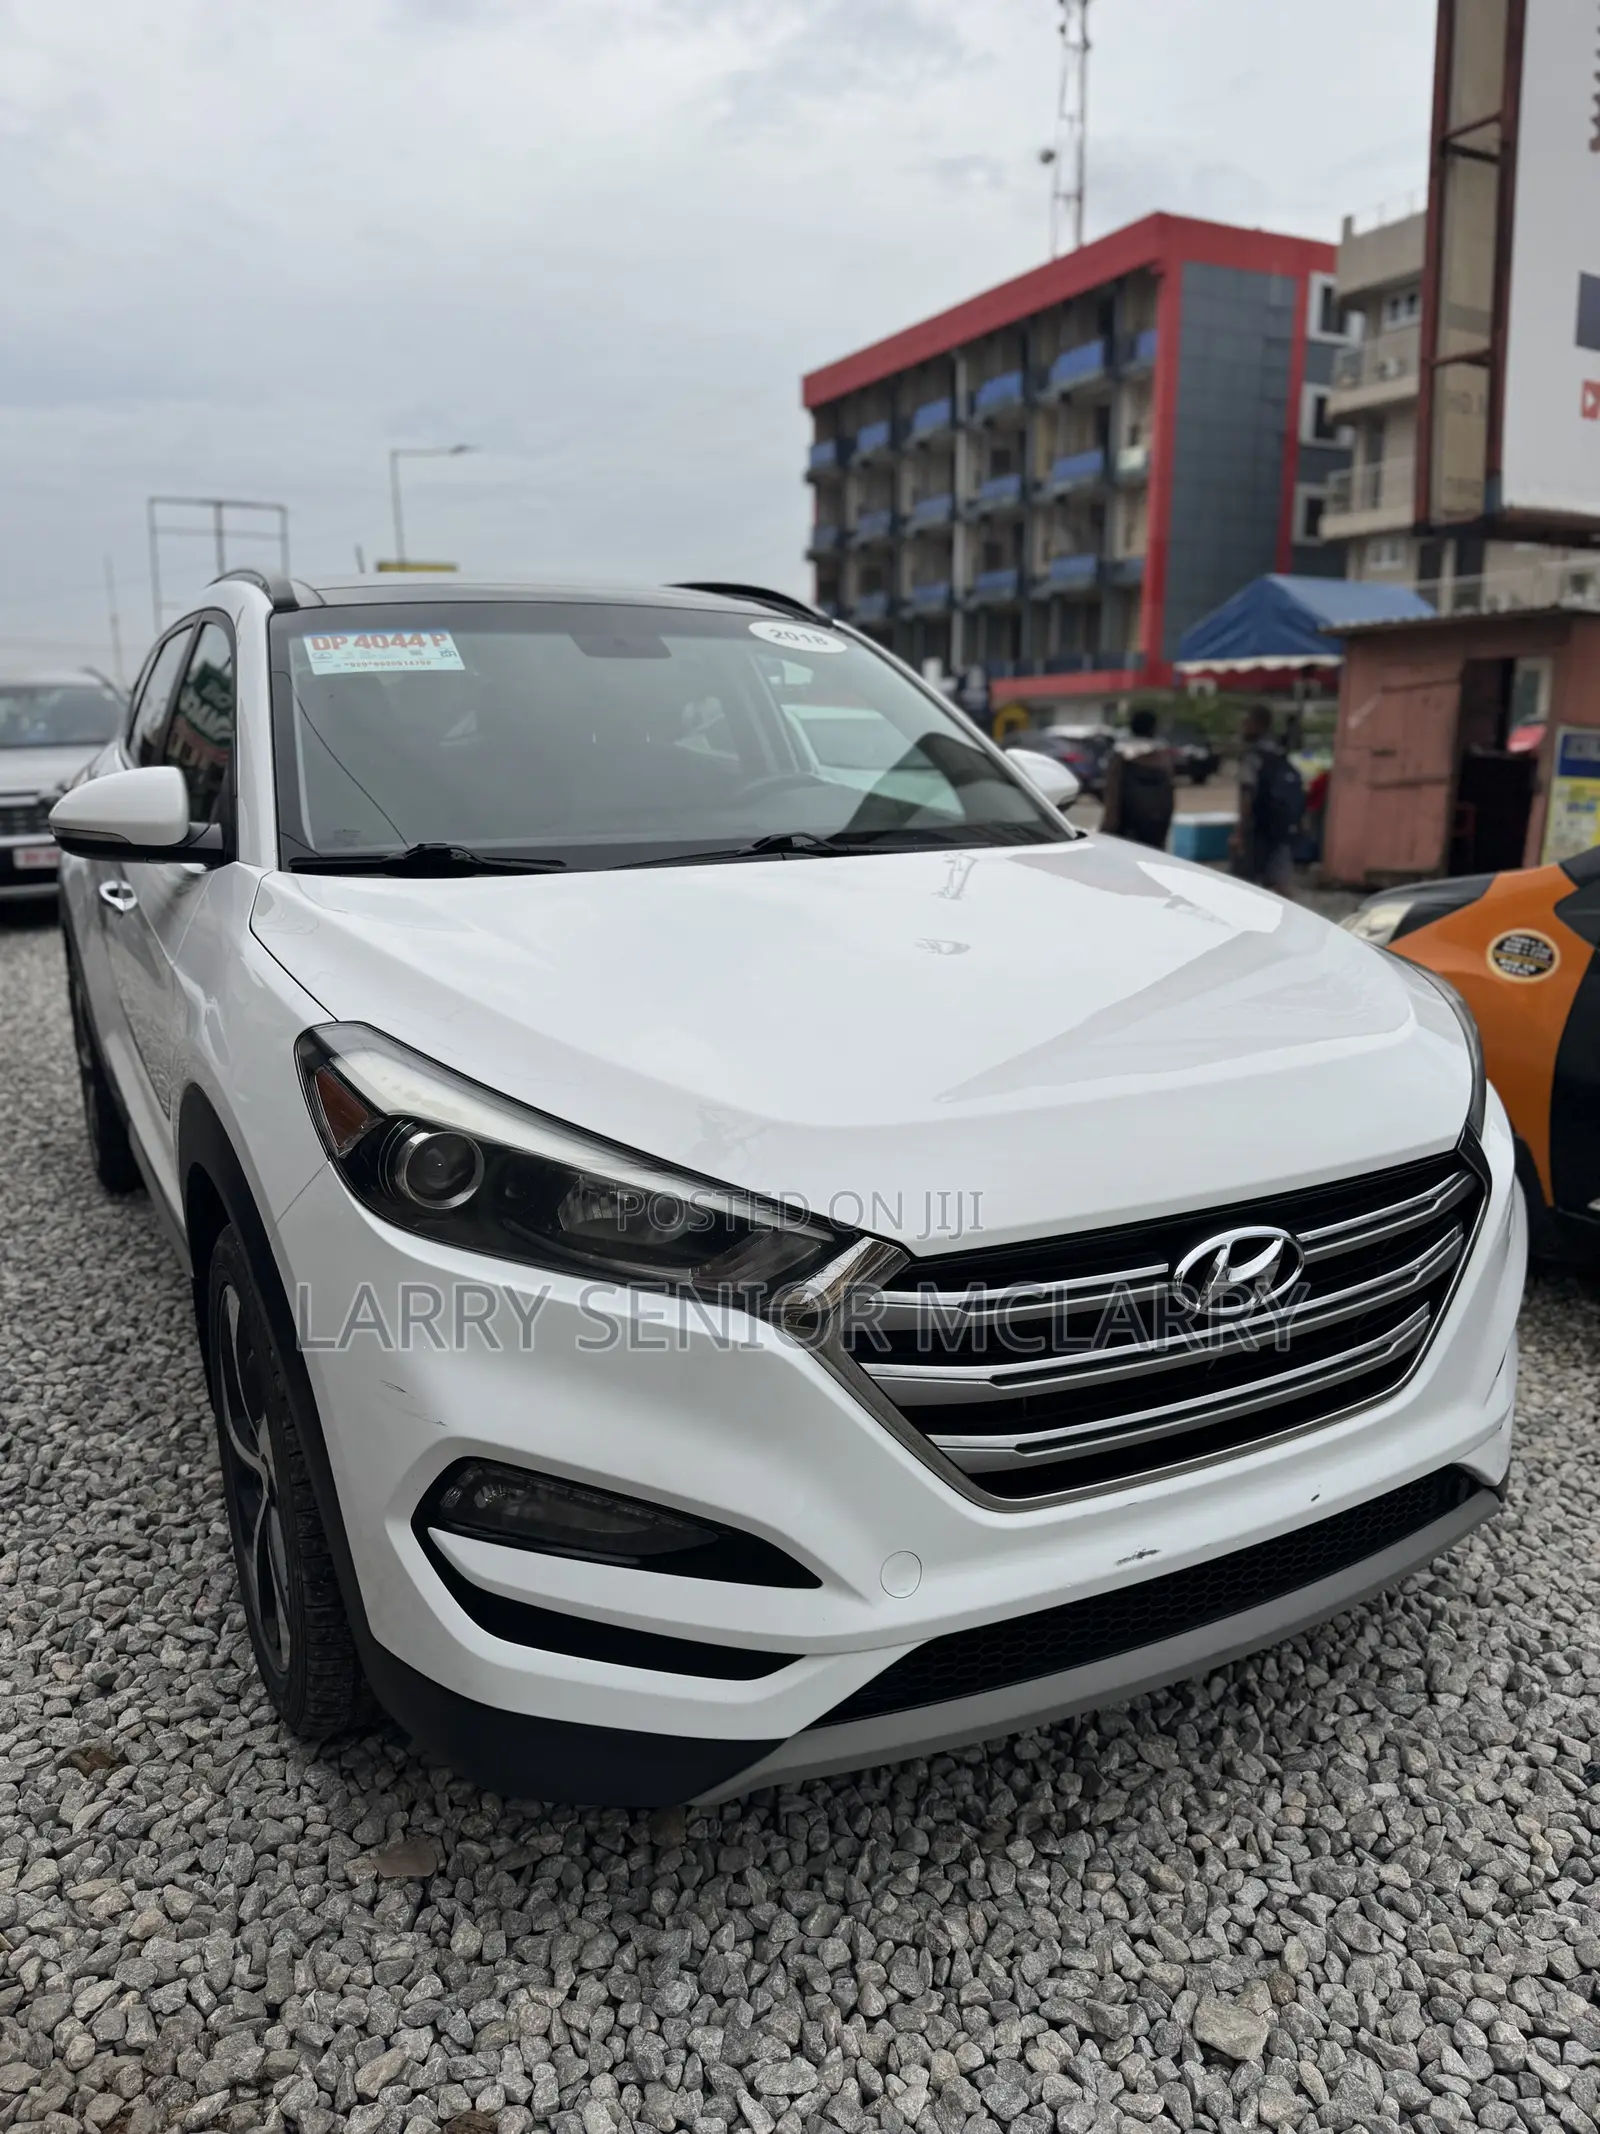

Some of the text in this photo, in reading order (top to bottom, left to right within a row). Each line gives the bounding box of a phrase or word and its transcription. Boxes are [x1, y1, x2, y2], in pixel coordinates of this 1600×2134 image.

[310, 632, 448, 651] DP 4044 P
